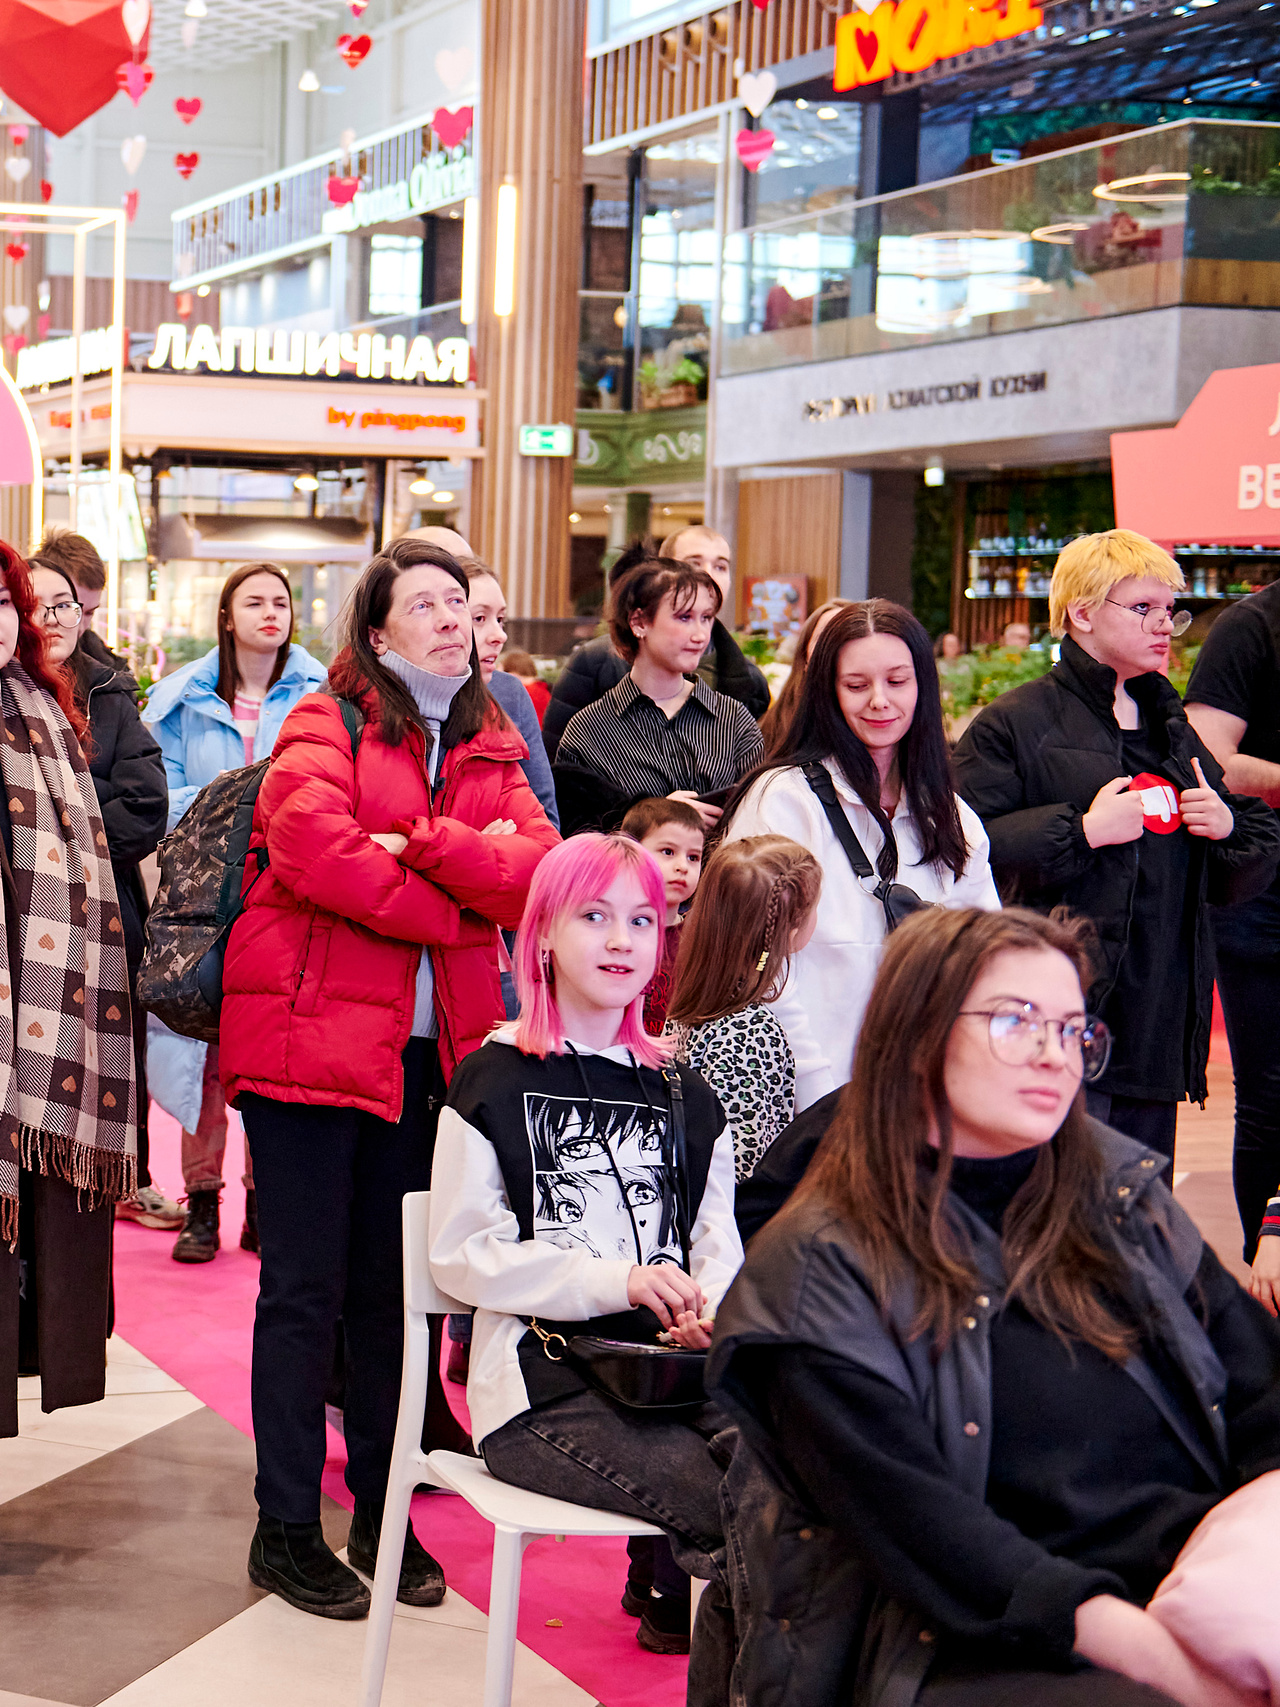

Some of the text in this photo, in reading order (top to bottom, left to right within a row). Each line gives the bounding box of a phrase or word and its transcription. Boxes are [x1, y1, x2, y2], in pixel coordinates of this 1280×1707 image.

[147, 321, 470, 383] ЛАПШИЧНАЯ
[989, 369, 1047, 398] КУХНИ
[328, 406, 466, 433] by pingpong
